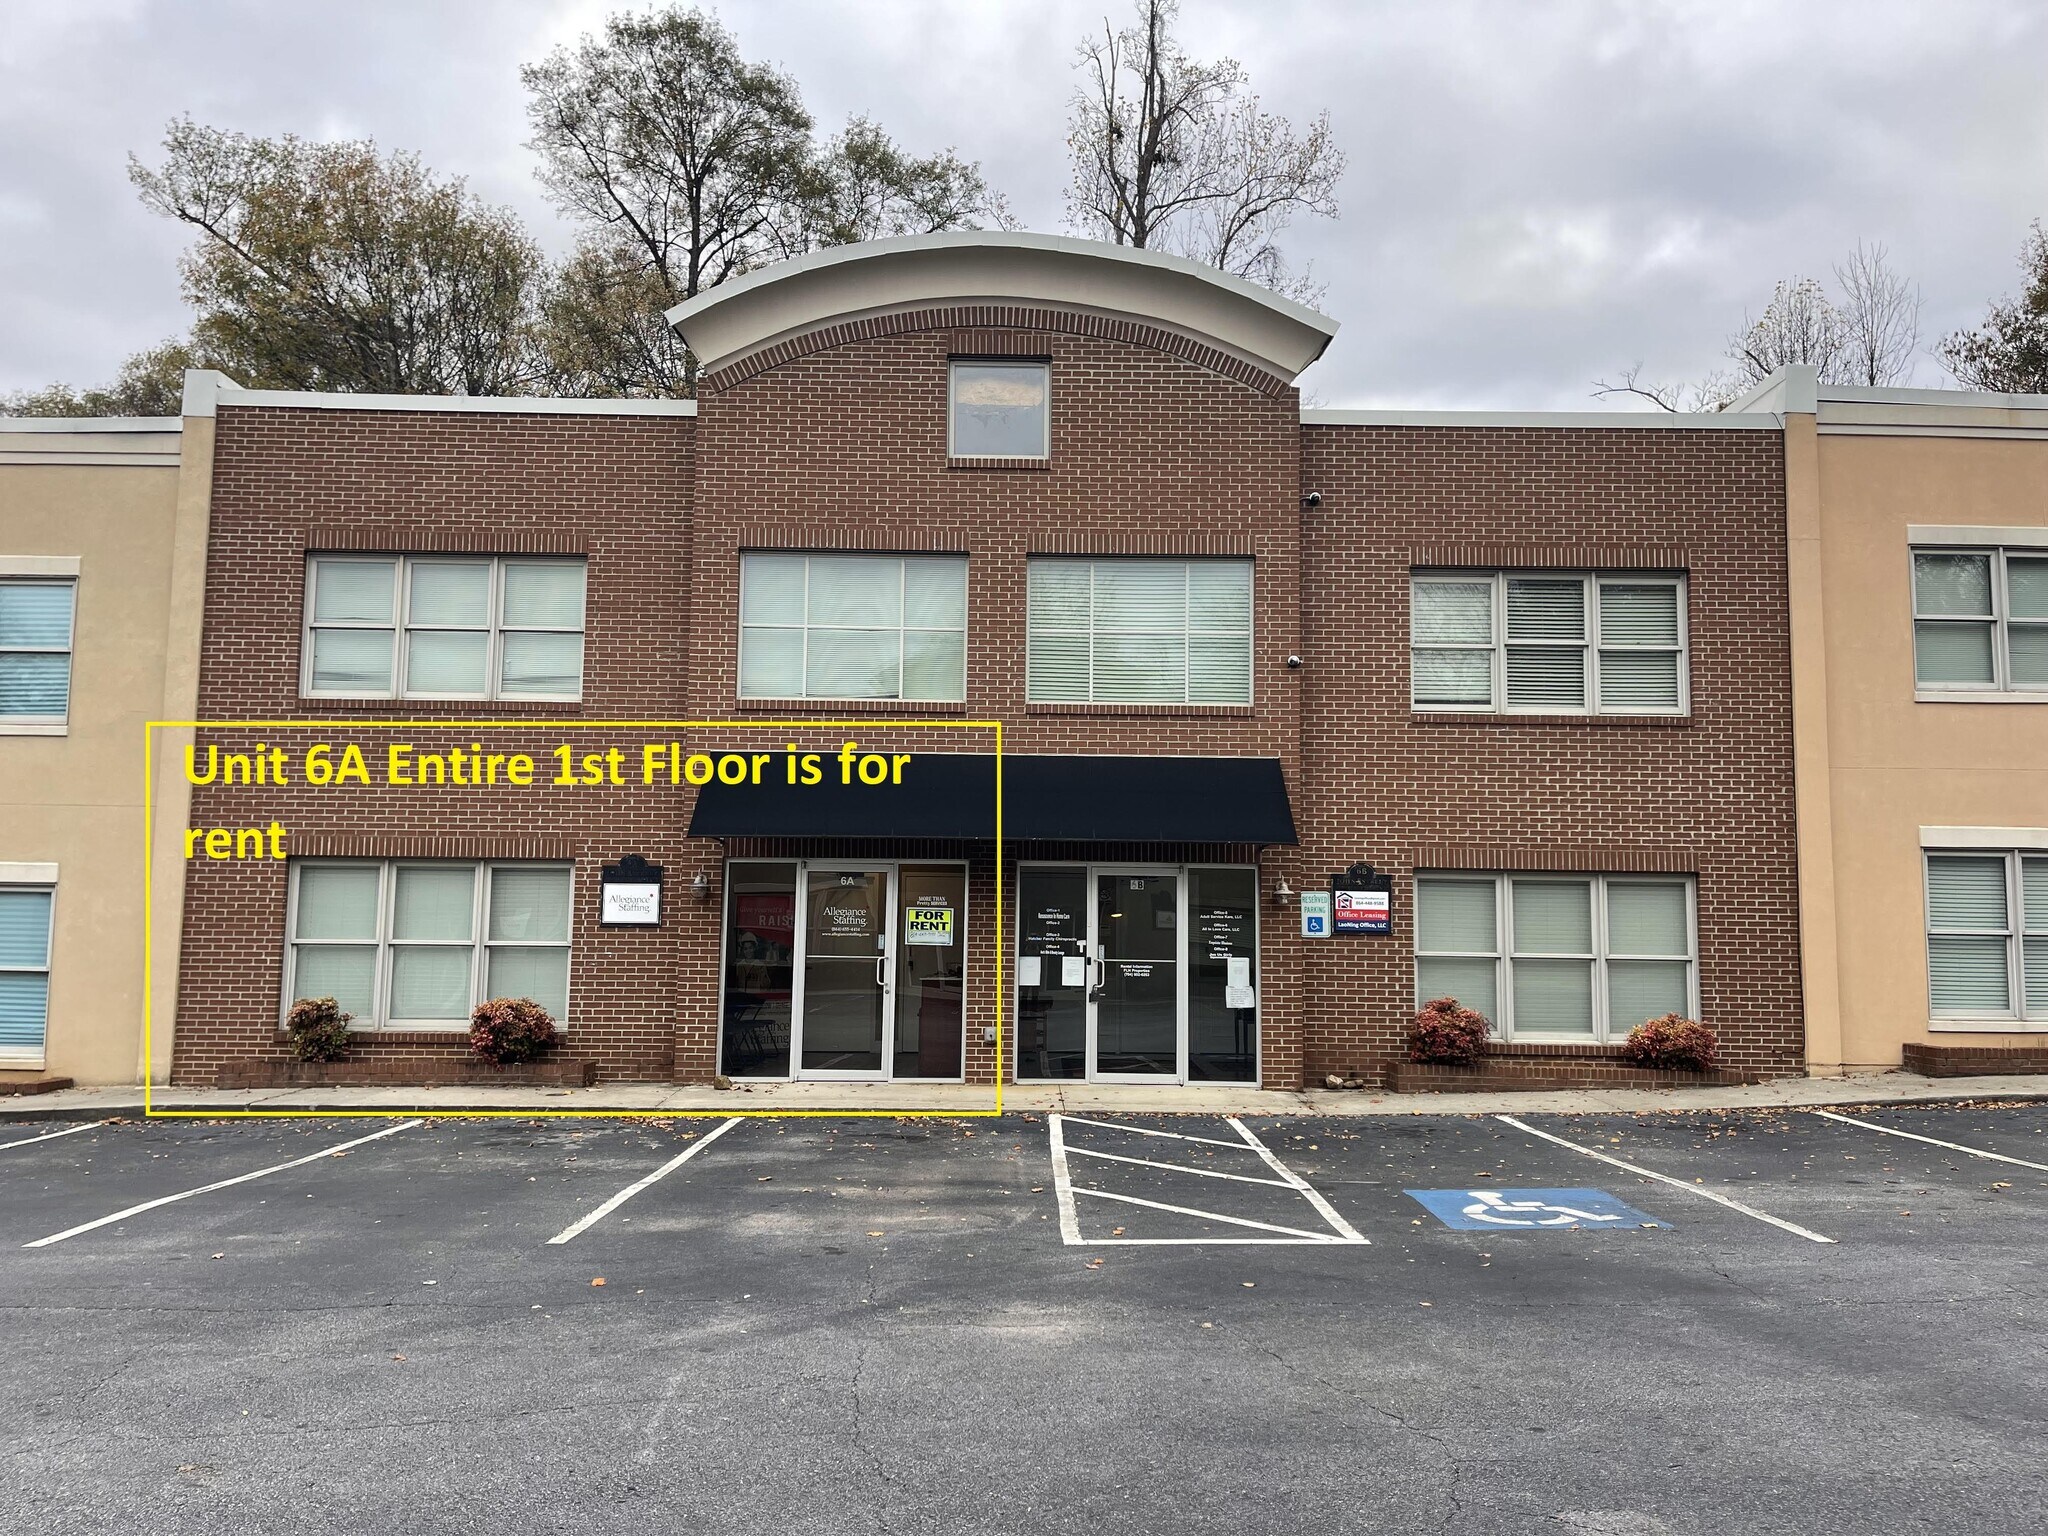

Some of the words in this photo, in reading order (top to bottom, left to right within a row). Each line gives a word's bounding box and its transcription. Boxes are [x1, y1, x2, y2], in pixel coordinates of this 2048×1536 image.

[840, 876, 855, 886] 6A
[1131, 880, 1143, 889] 6B
[609, 894, 650, 905] Allegiance
[1302, 896, 1328, 904] RESERVED
[823, 906, 867, 917] Allegiance
[1303, 906, 1326, 914] PARKING
[915, 911, 944, 921] FOR
[1360, 911, 1387, 920] Leasing
[910, 921, 949, 931] RENT
